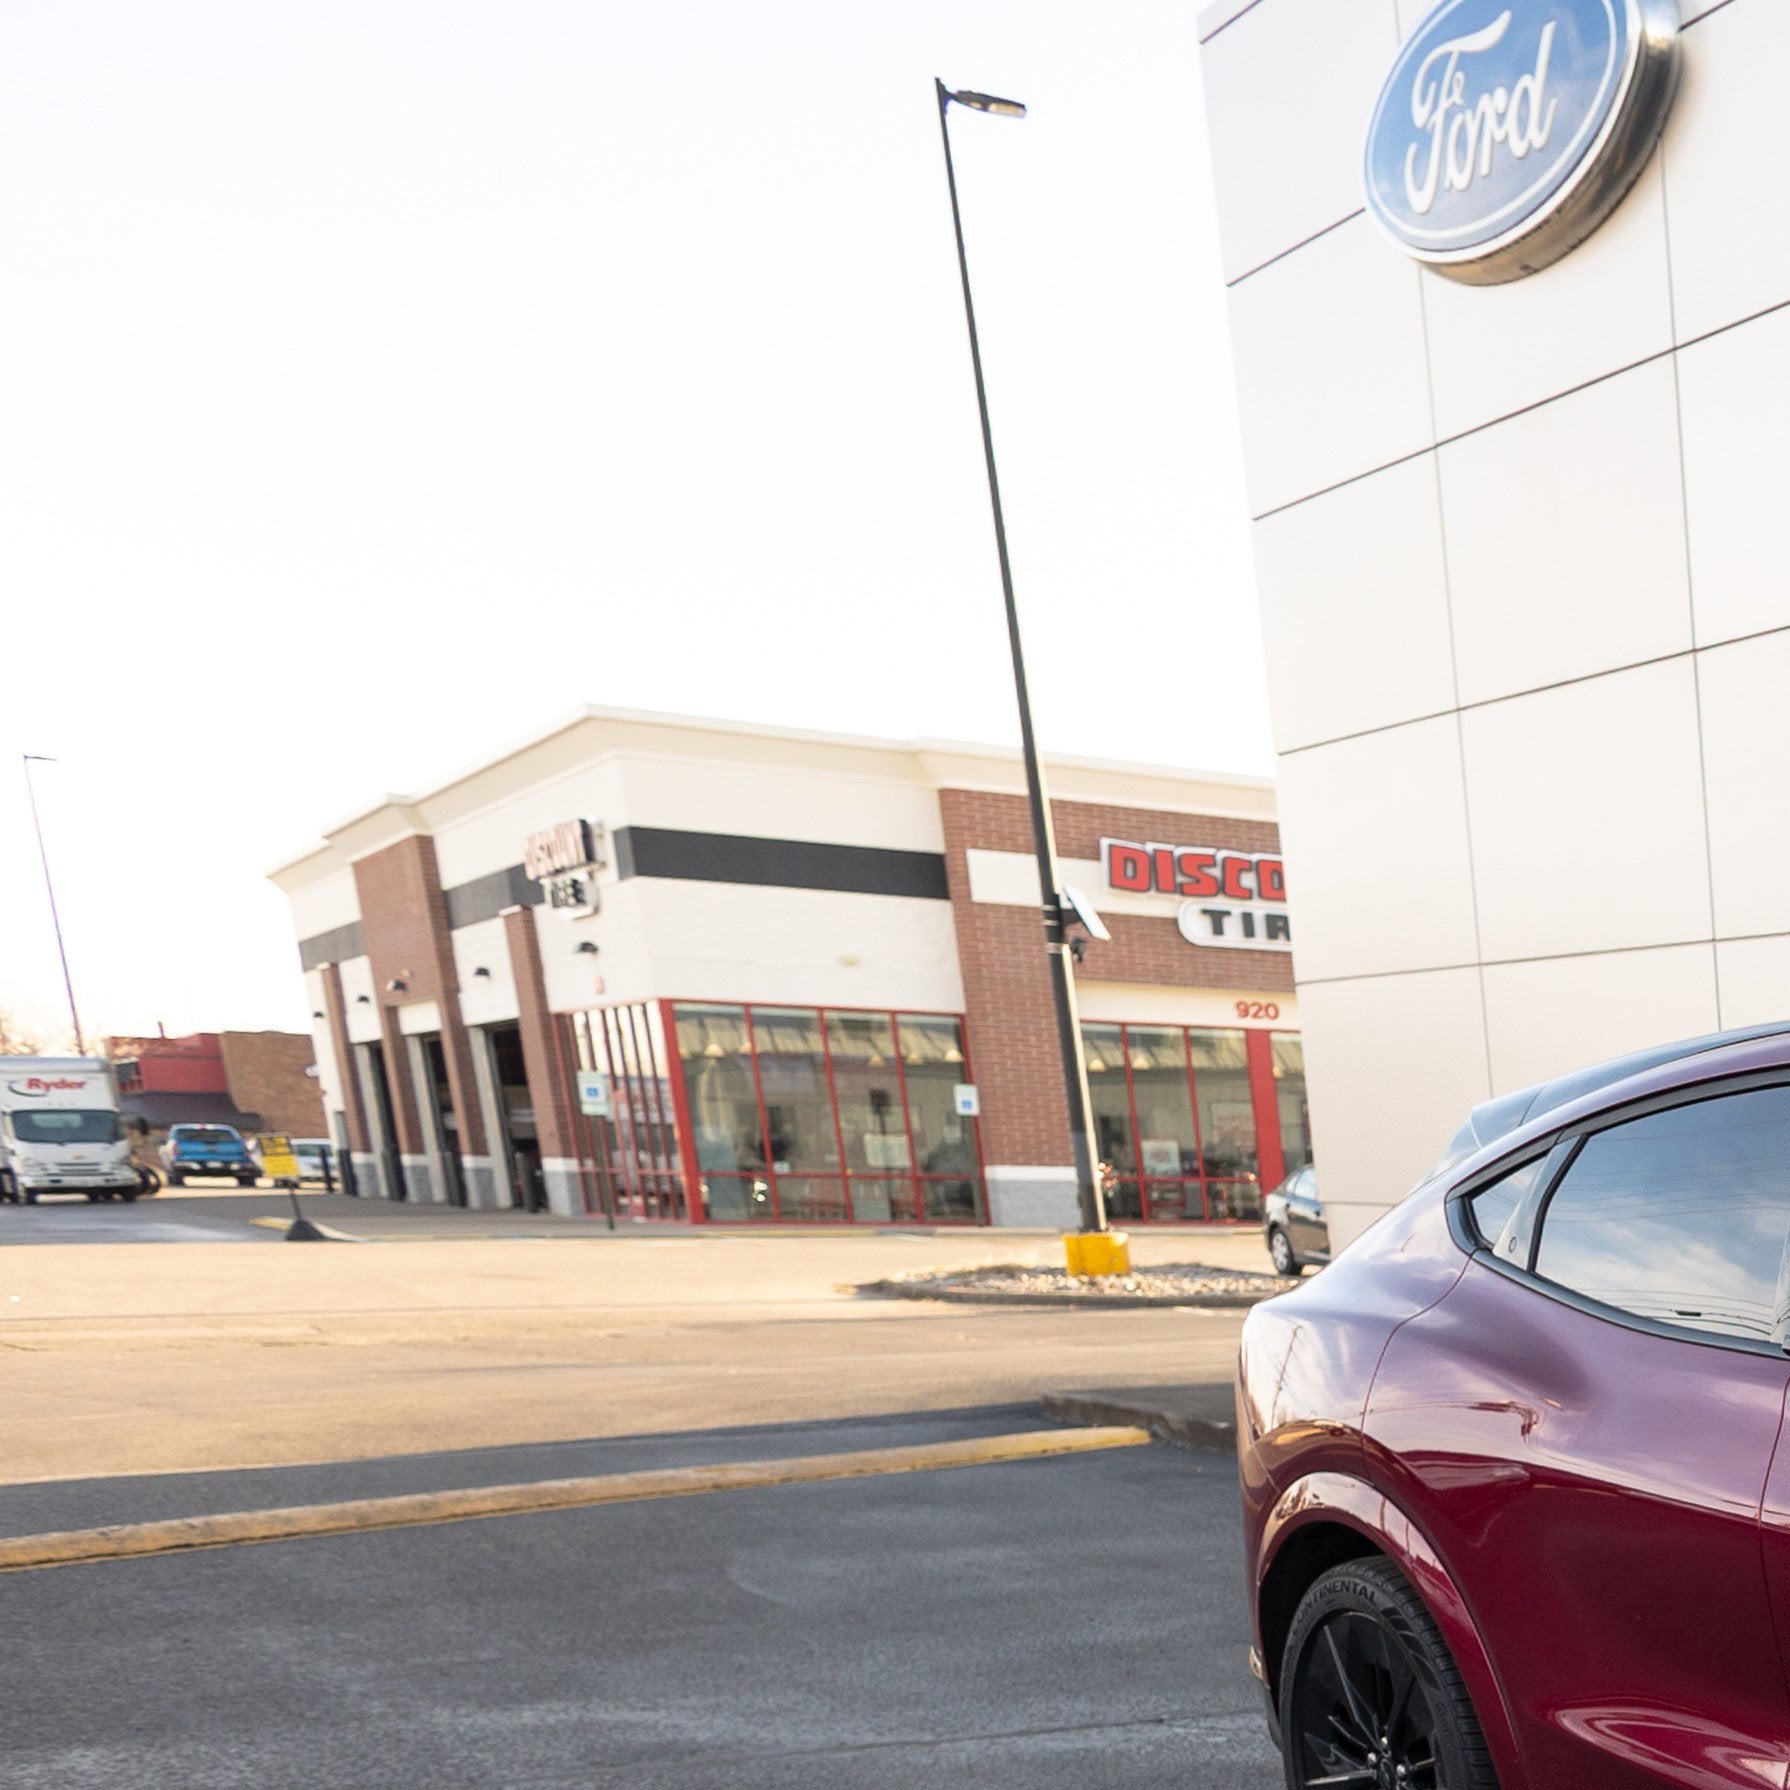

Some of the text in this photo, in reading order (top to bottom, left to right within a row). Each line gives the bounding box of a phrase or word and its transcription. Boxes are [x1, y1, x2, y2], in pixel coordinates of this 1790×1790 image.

[1404, 9, 1558, 214] Ford
[1109, 844, 1287, 902] DISCO
[1235, 1000, 1280, 1020] 920
